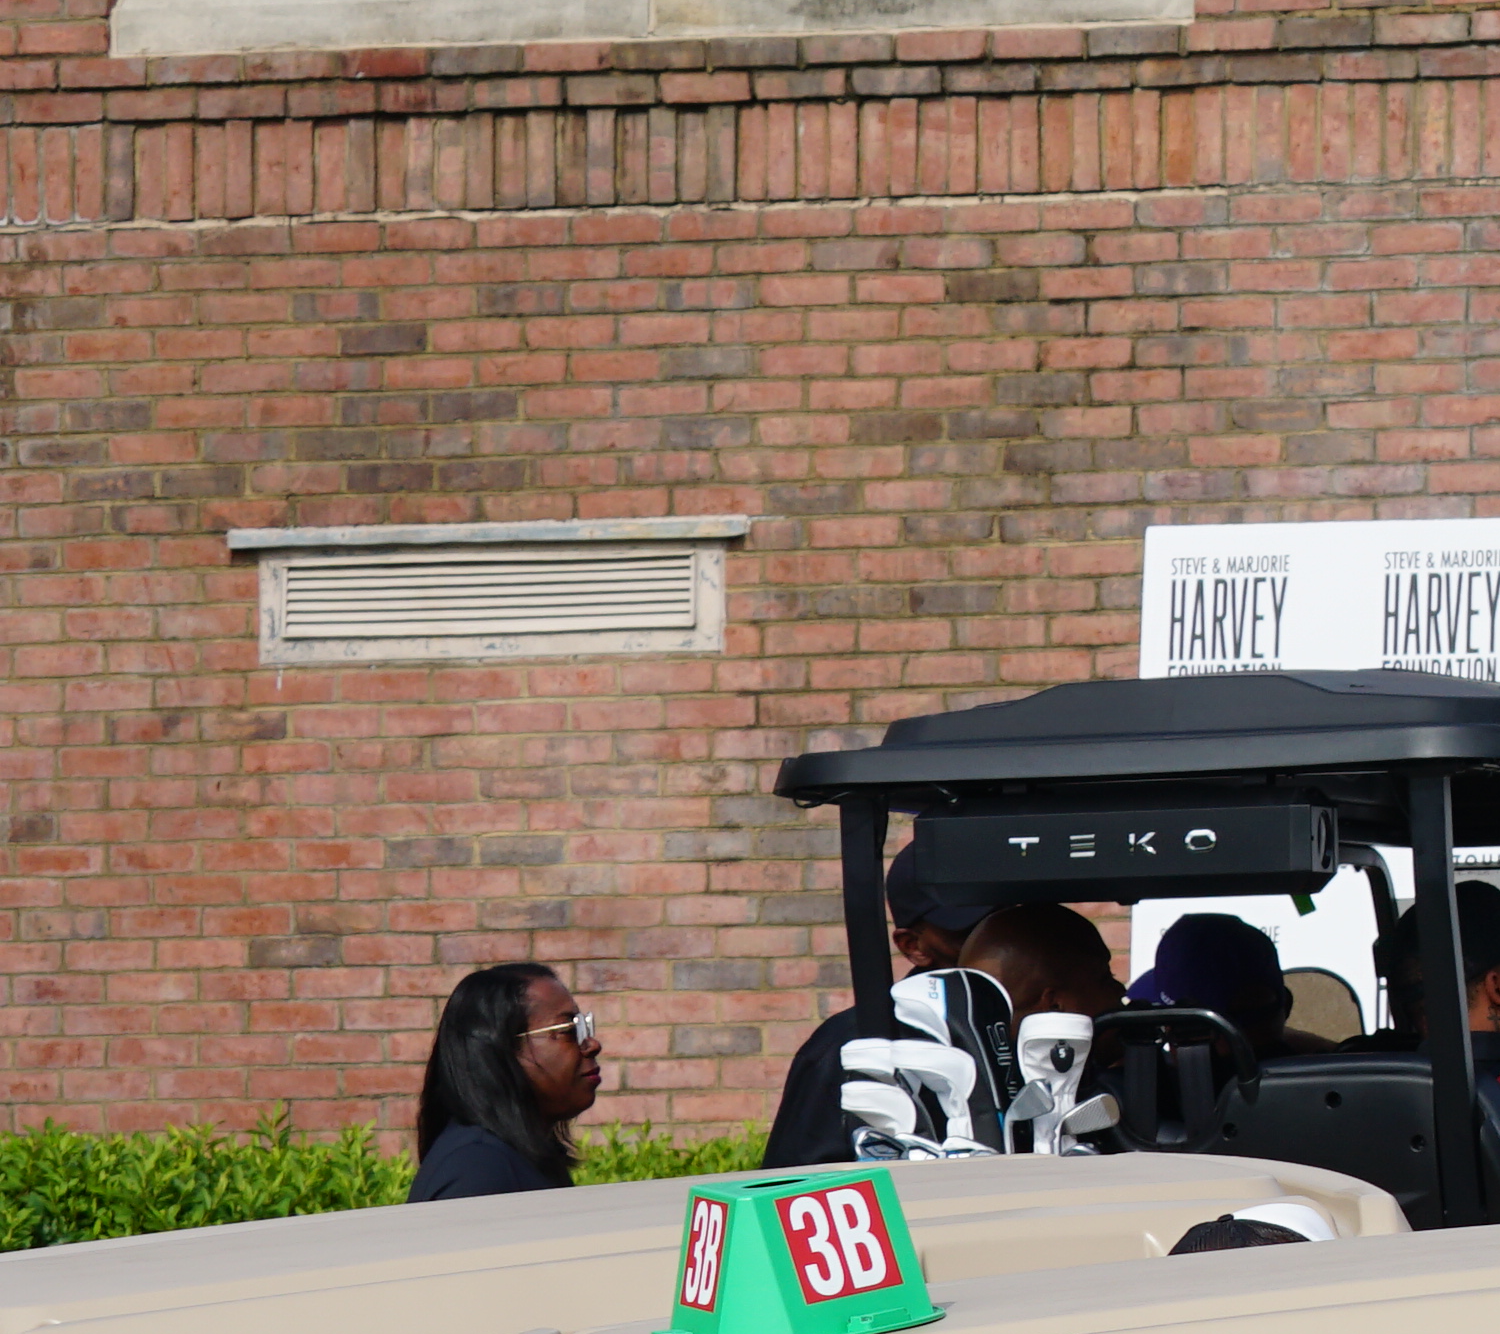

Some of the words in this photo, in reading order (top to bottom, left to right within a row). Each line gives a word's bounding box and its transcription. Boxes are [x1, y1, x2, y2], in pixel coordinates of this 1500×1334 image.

[1008, 829, 1217, 858] TEKO
[685, 1201, 723, 1306] 3B
[789, 1188, 887, 1297] 3B
